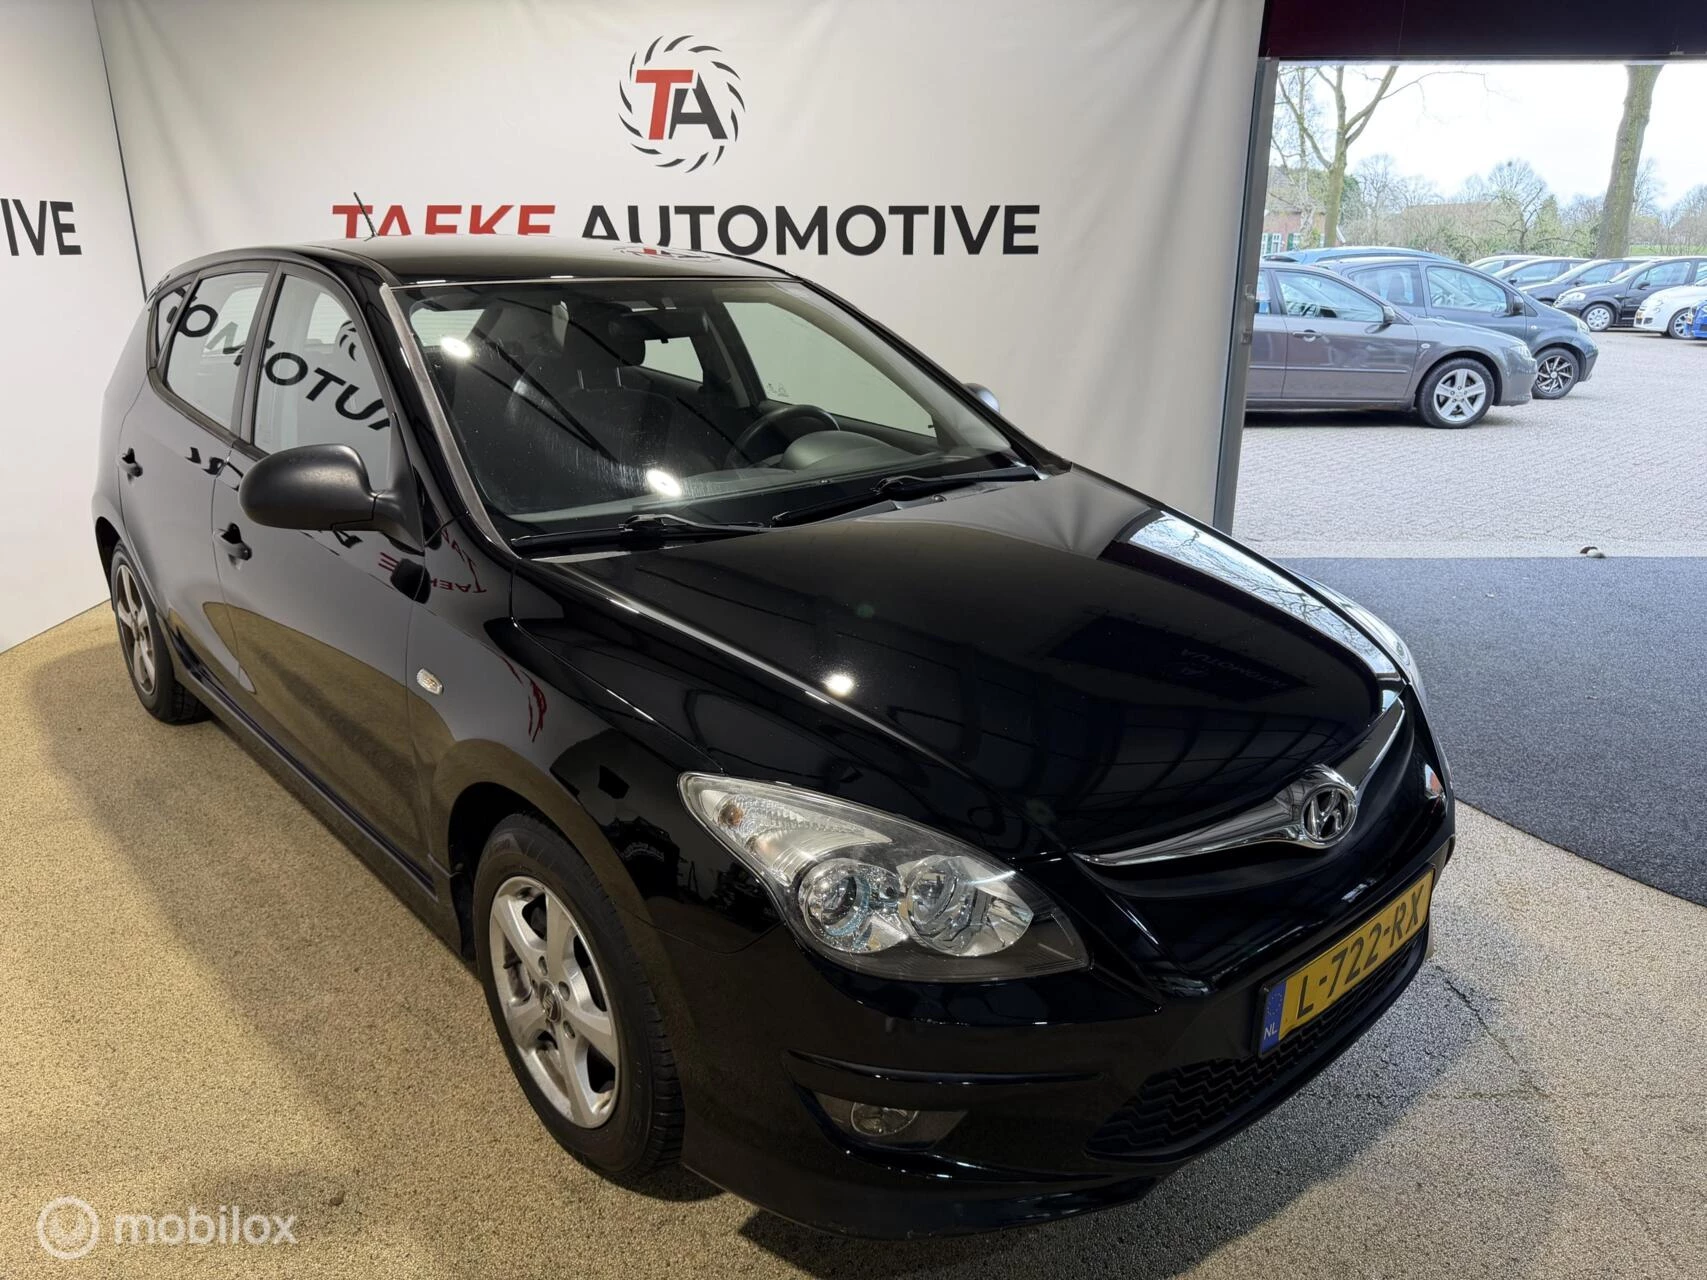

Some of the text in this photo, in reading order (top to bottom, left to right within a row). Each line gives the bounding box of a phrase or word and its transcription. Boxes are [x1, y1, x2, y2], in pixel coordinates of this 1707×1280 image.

[636, 69, 729, 140] TA
[581, 204, 1041, 256] AUTOMOTIVE
[1296, 884, 1425, 1020] L-722-RX
[1263, 1024, 1278, 1041] NL
